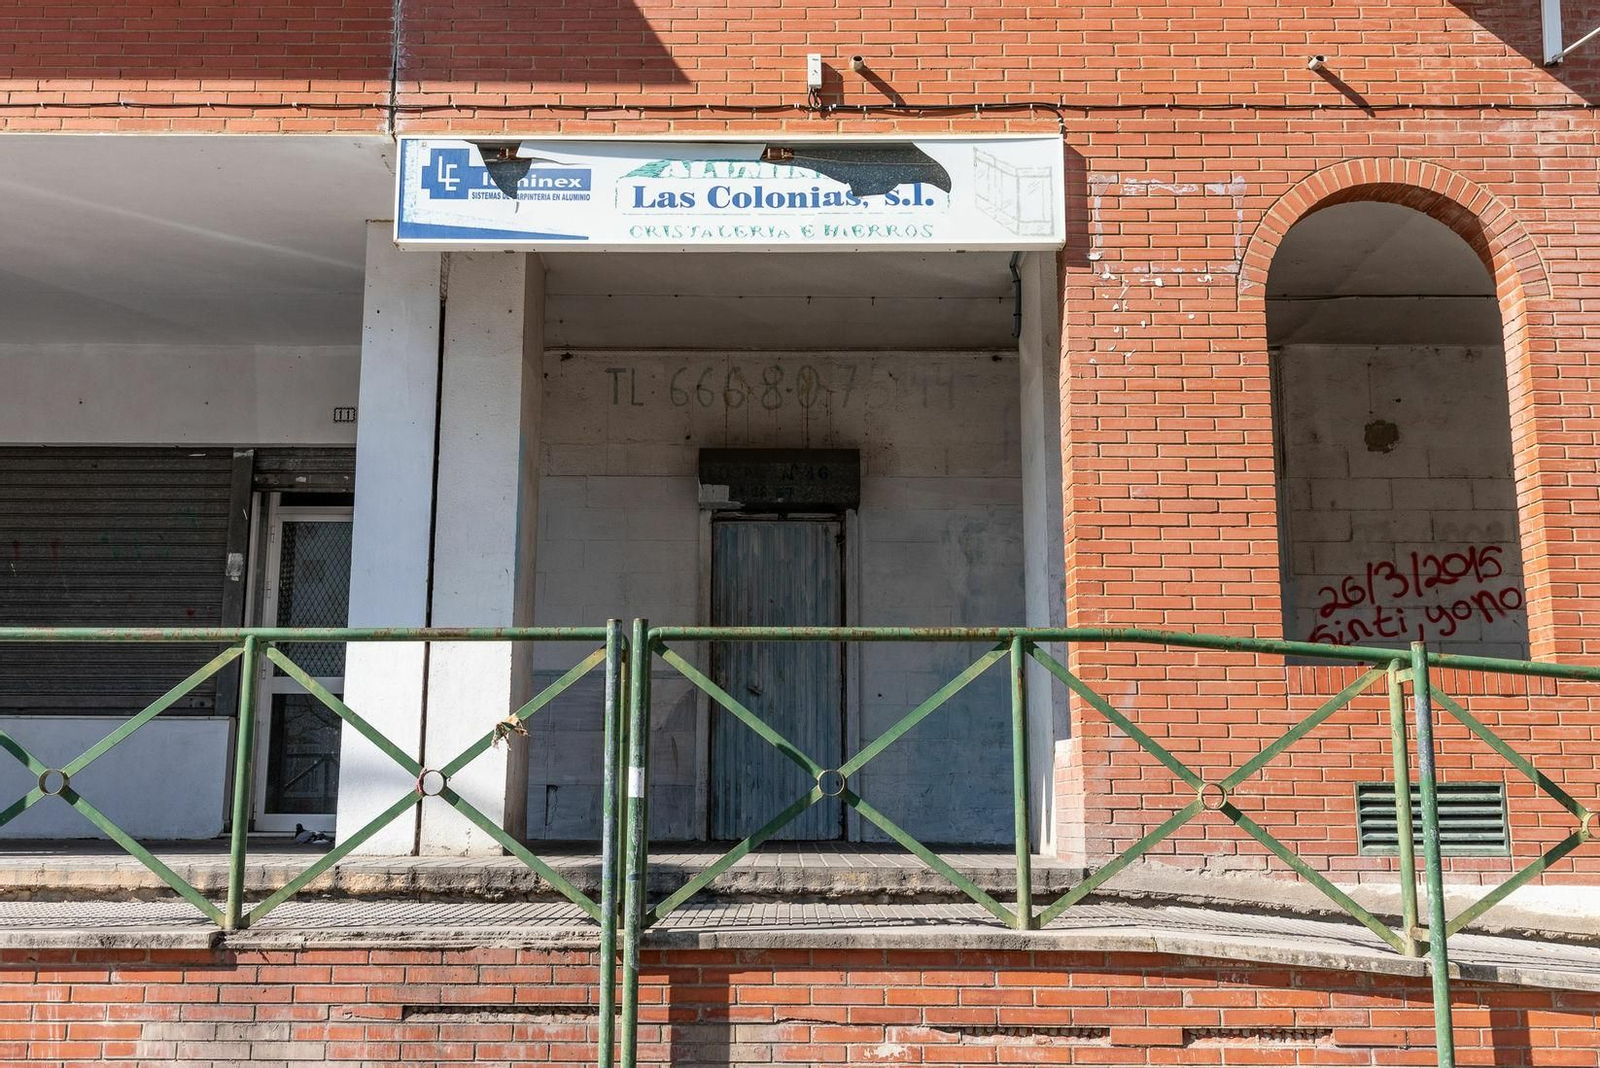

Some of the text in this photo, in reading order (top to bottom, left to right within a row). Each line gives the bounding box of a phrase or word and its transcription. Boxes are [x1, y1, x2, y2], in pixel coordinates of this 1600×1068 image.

[471, 191, 500, 200] SISTEMAS
[516, 192, 551, 201] ARPINTERIA
[552, 193, 560, 201] EN
[562, 193, 591, 201] ALUMINIO
[632, 185, 696, 209] Las
[823, 224, 934, 239] HIERROS
